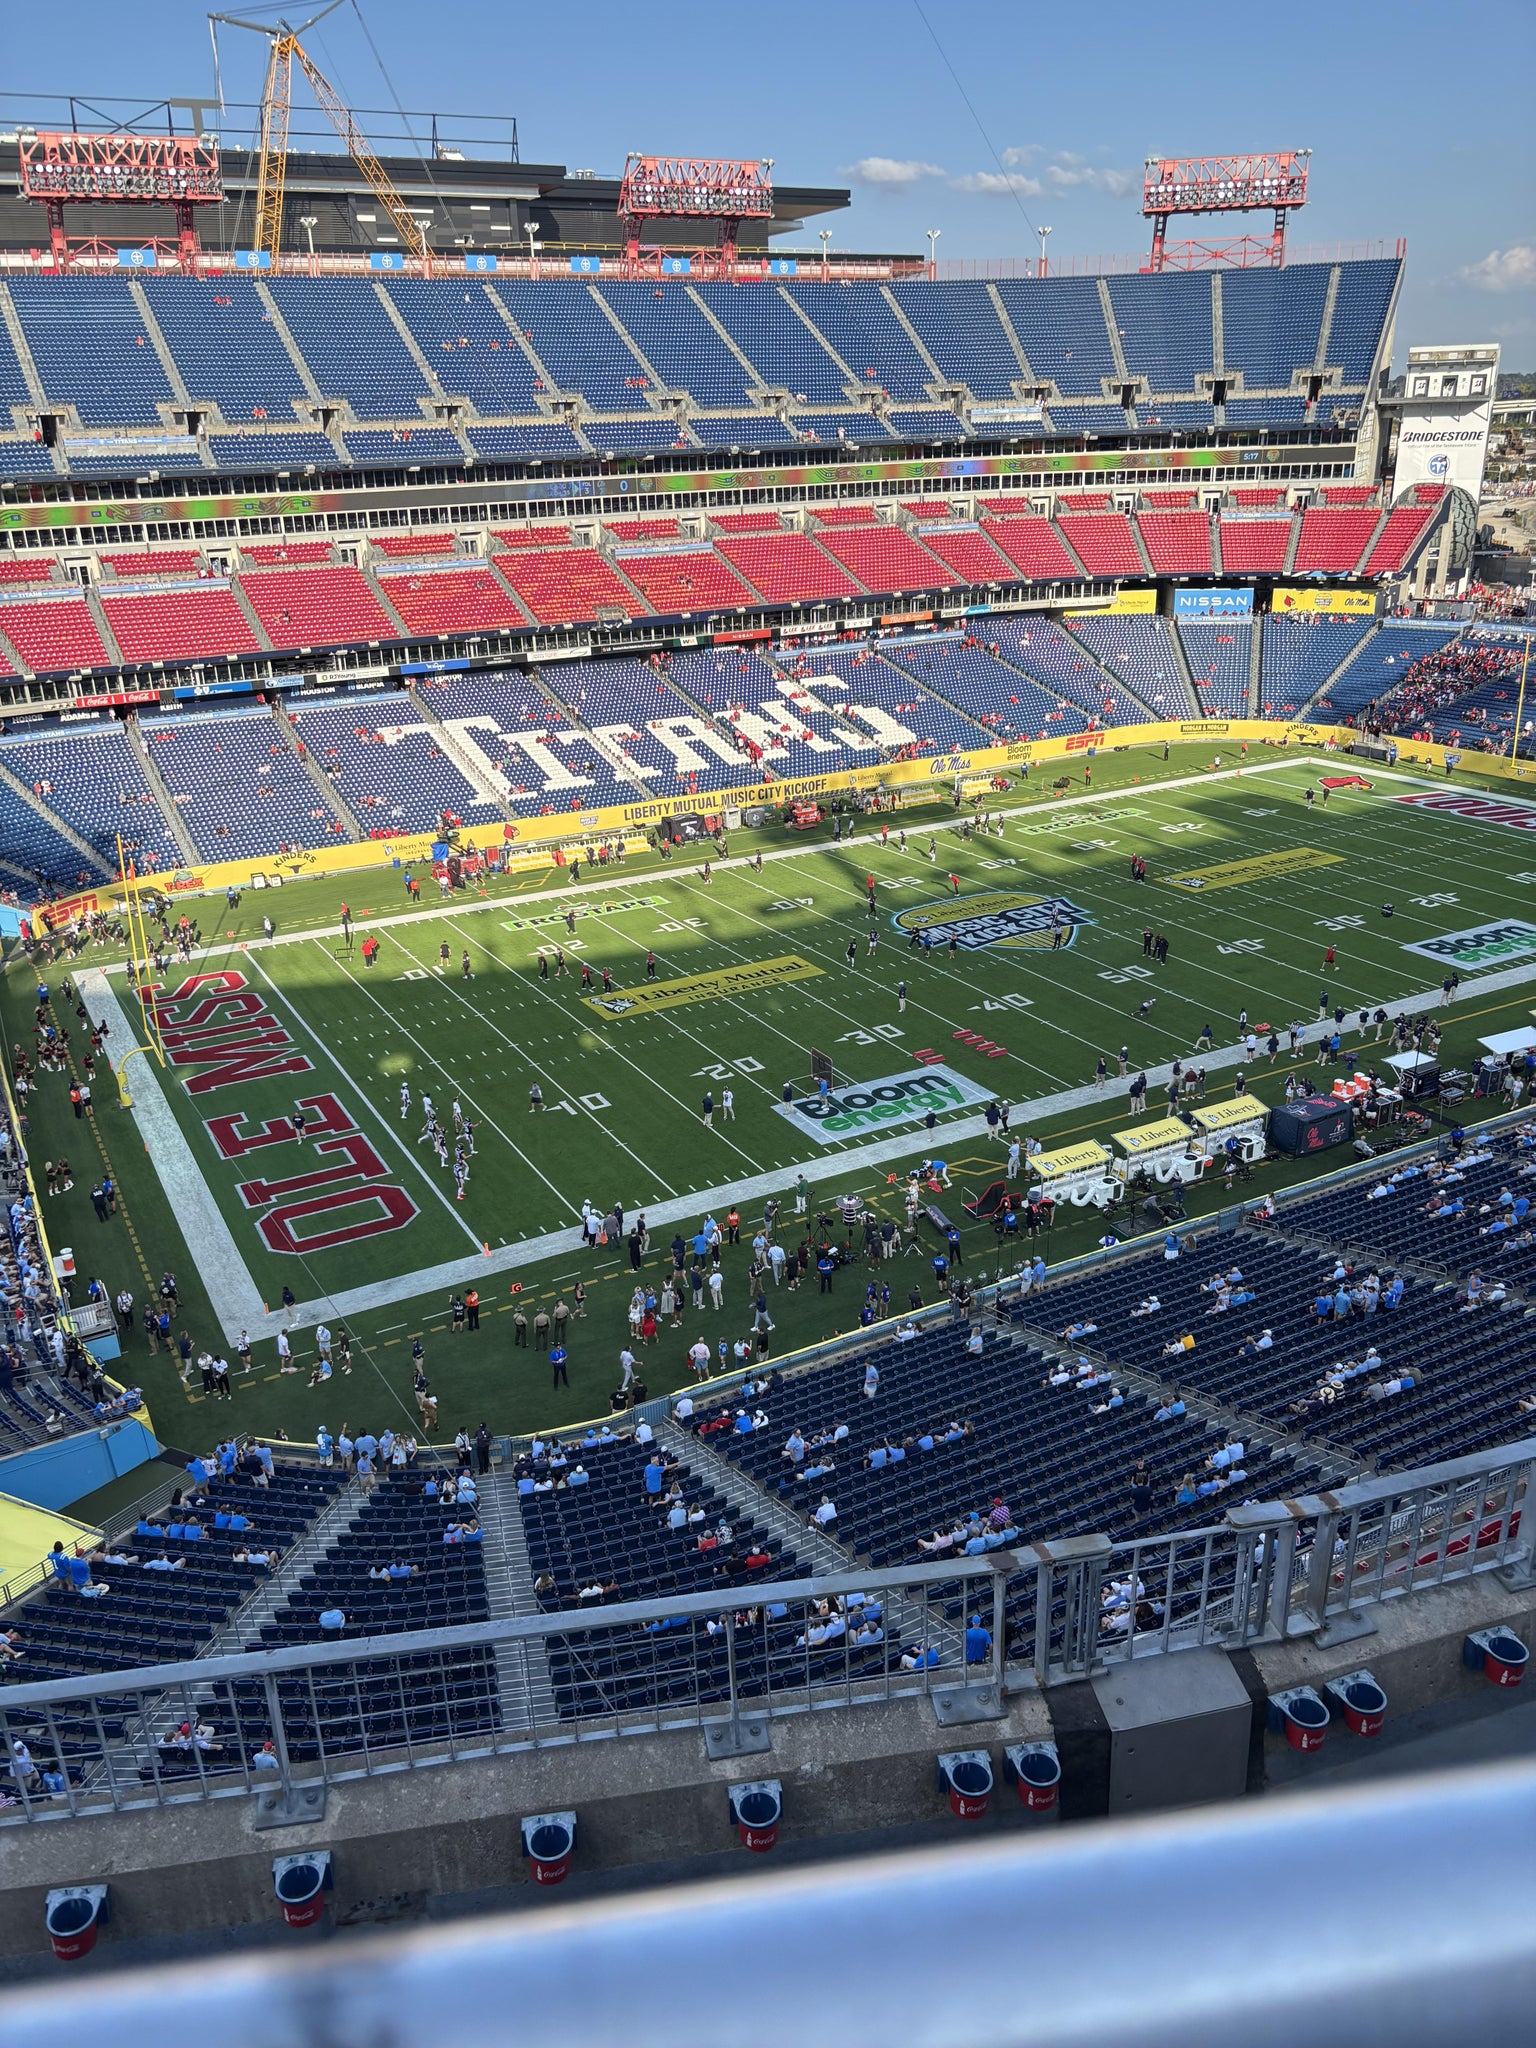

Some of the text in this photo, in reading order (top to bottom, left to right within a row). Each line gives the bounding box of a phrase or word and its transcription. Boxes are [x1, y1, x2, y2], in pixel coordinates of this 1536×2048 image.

[1402, 430, 1485, 442] BRIDGESTONE
[619, 480, 628, 492] 0
[1179, 596, 1248, 607] NISSAN
[300, 686, 336, 696] HOUSTON
[160, 703, 183, 711] KEITH
[11, 713, 45, 724] HONOR
[60, 712, 91, 722] ADAMS
[376, 676, 918, 806] TITANS
[1007, 744, 1032, 756] Bloom
[1065, 733, 1105, 751] ESPN
[930, 756, 972, 774] Ole Miss
[1007, 751, 1032, 761] energy
[624, 779, 828, 821] LIBERTY MUTUAL MUSIC CITY KICKOFF
[1202, 859, 1267, 880] Liberty
[1246, 862, 1313, 880] INSURANCE
[164, 877, 205, 892] T-REX
[45, 893, 98, 927] ESPN
[513, 897, 658, 928] FROGTAPE
[659, 916, 709, 933] 30
[922, 901, 1076, 944] MUSIC CITY
[957, 913, 1074, 947] KICKOFF
[1313, 914, 1367, 932] 30
[536, 939, 589, 957] 20
[1216, 938, 1266, 955] 40
[1417, 925, 1535, 955] Bloom
[403, 965, 446, 981] 10
[1096, 965, 1156, 984] 50
[636, 979, 721, 1001] Liberty
[687, 977, 783, 1001] INSURANCE
[982, 993, 1035, 1011] 40
[131, 970, 317, 1096] MISS
[843, 1023, 906, 1046] 30
[701, 1056, 766, 1081] 20
[559, 1092, 612, 1115] 10
[793, 1074, 953, 1120] Bloom
[821, 1085, 967, 1132] energy
[202, 1092, 422, 1255] OLE
[514, 1284, 522, 1293] G
[543, 1865, 566, 1878] Coca-Cola
